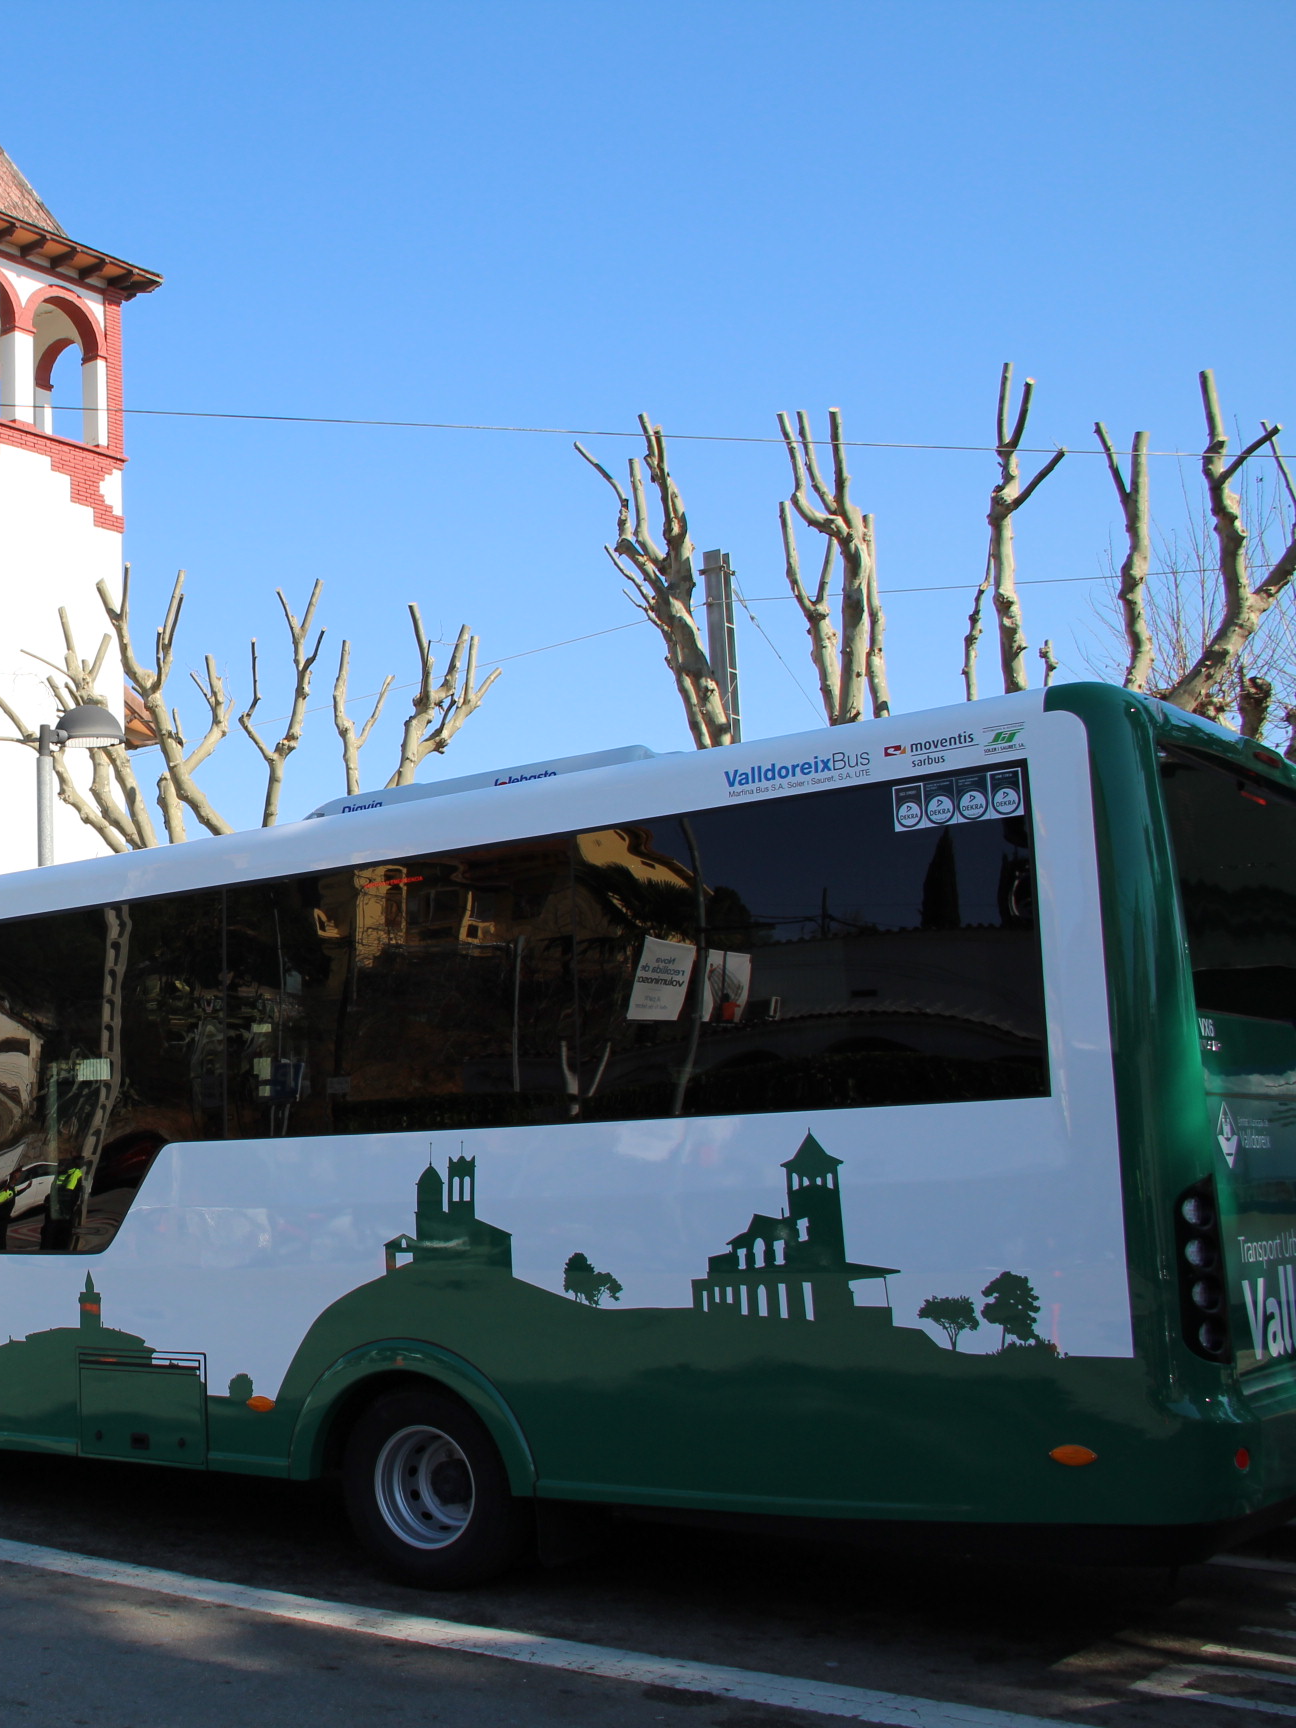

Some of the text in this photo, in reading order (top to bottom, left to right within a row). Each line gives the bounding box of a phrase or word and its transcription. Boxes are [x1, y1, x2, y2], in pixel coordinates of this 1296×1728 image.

[910, 731, 974, 752] moventis
[911, 755, 945, 768] sarbus
[724, 751, 871, 788] ValldoreixBus
[728, 788, 754, 798] Marfina
[770, 783, 785, 792] S.A.
[786, 780, 807, 789] Soler
[838, 772, 853, 781] S.A.
[854, 768, 871, 778] UTE
[961, 803, 984, 812] DEKRA
[996, 799, 1017, 808] DEKRA
[899, 812, 919, 821] DEKRA
[929, 808, 951, 816] DEKRA
[1237, 1235, 1282, 1269] Transport
